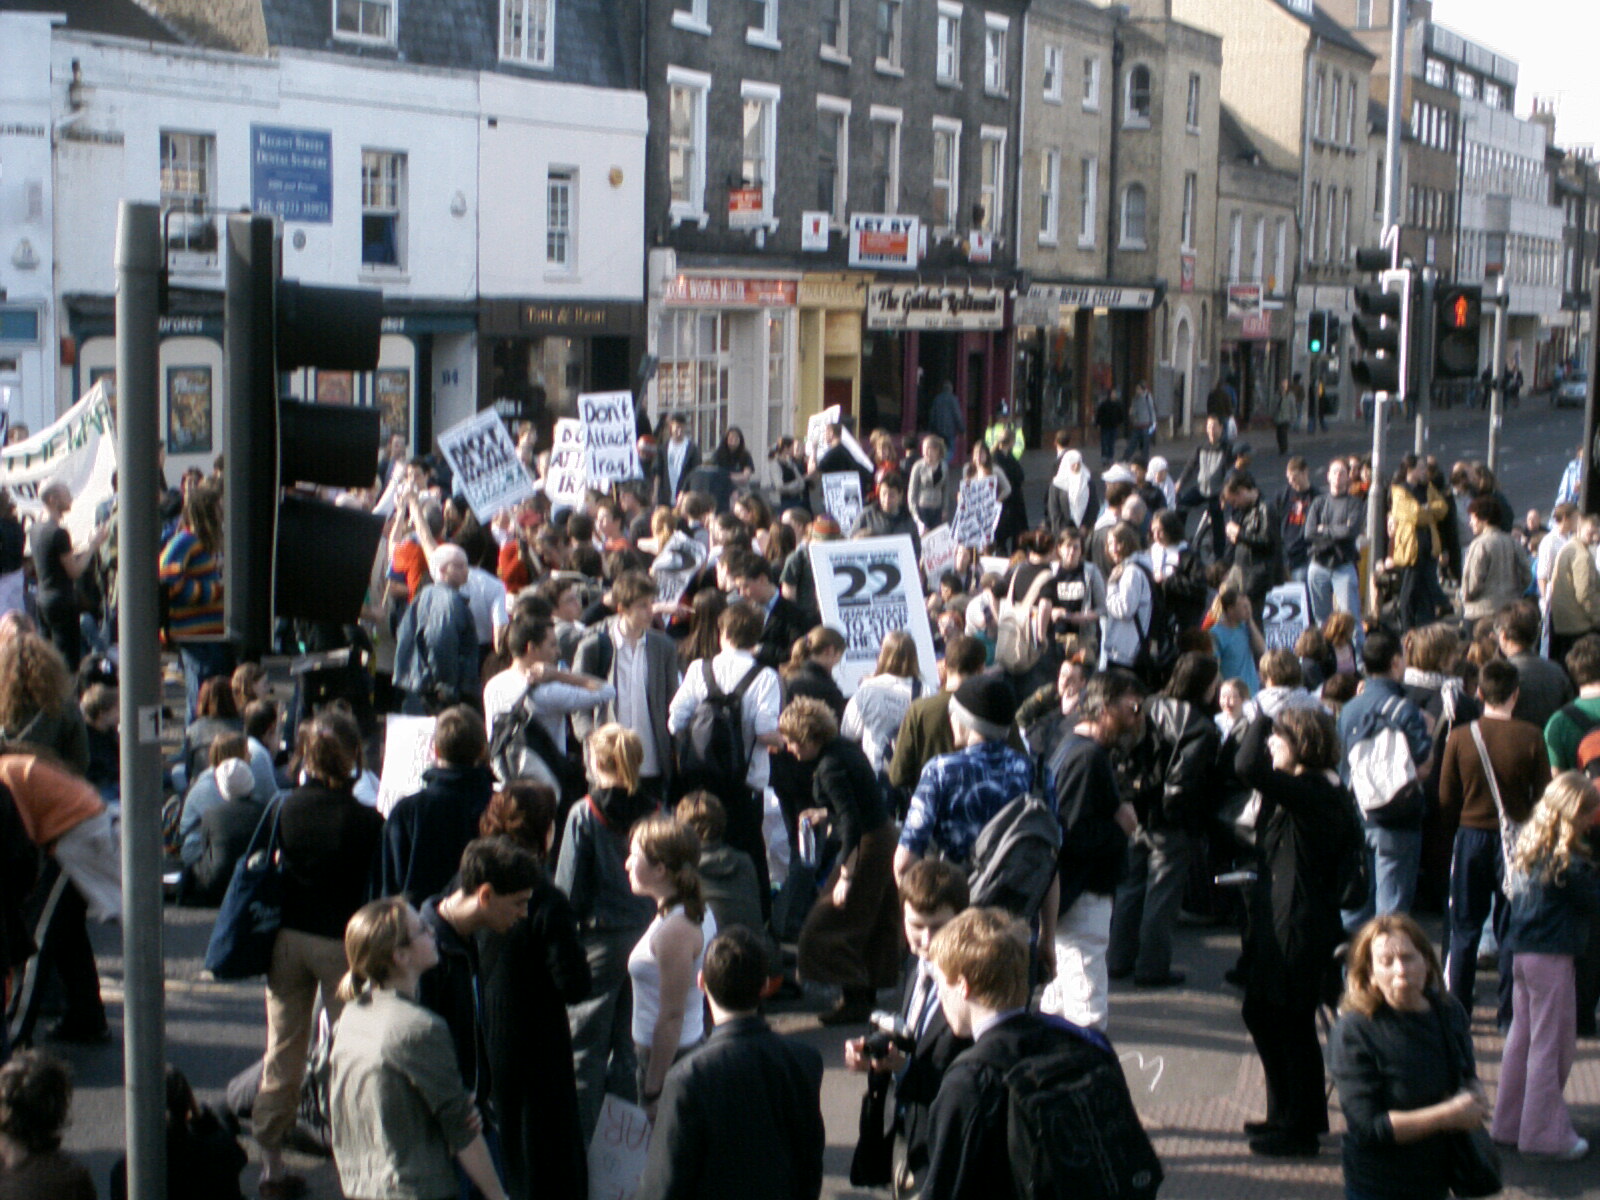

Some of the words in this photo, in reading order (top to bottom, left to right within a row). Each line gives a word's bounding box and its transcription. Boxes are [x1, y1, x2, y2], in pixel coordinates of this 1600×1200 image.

[854, 217, 883, 231] LET
[890, 218, 913, 231] BY
[584, 396, 631, 424] Don't
[586, 427, 632, 448] Attack
[591, 449, 634, 476] Iraq!
[833, 563, 903, 605] 22
